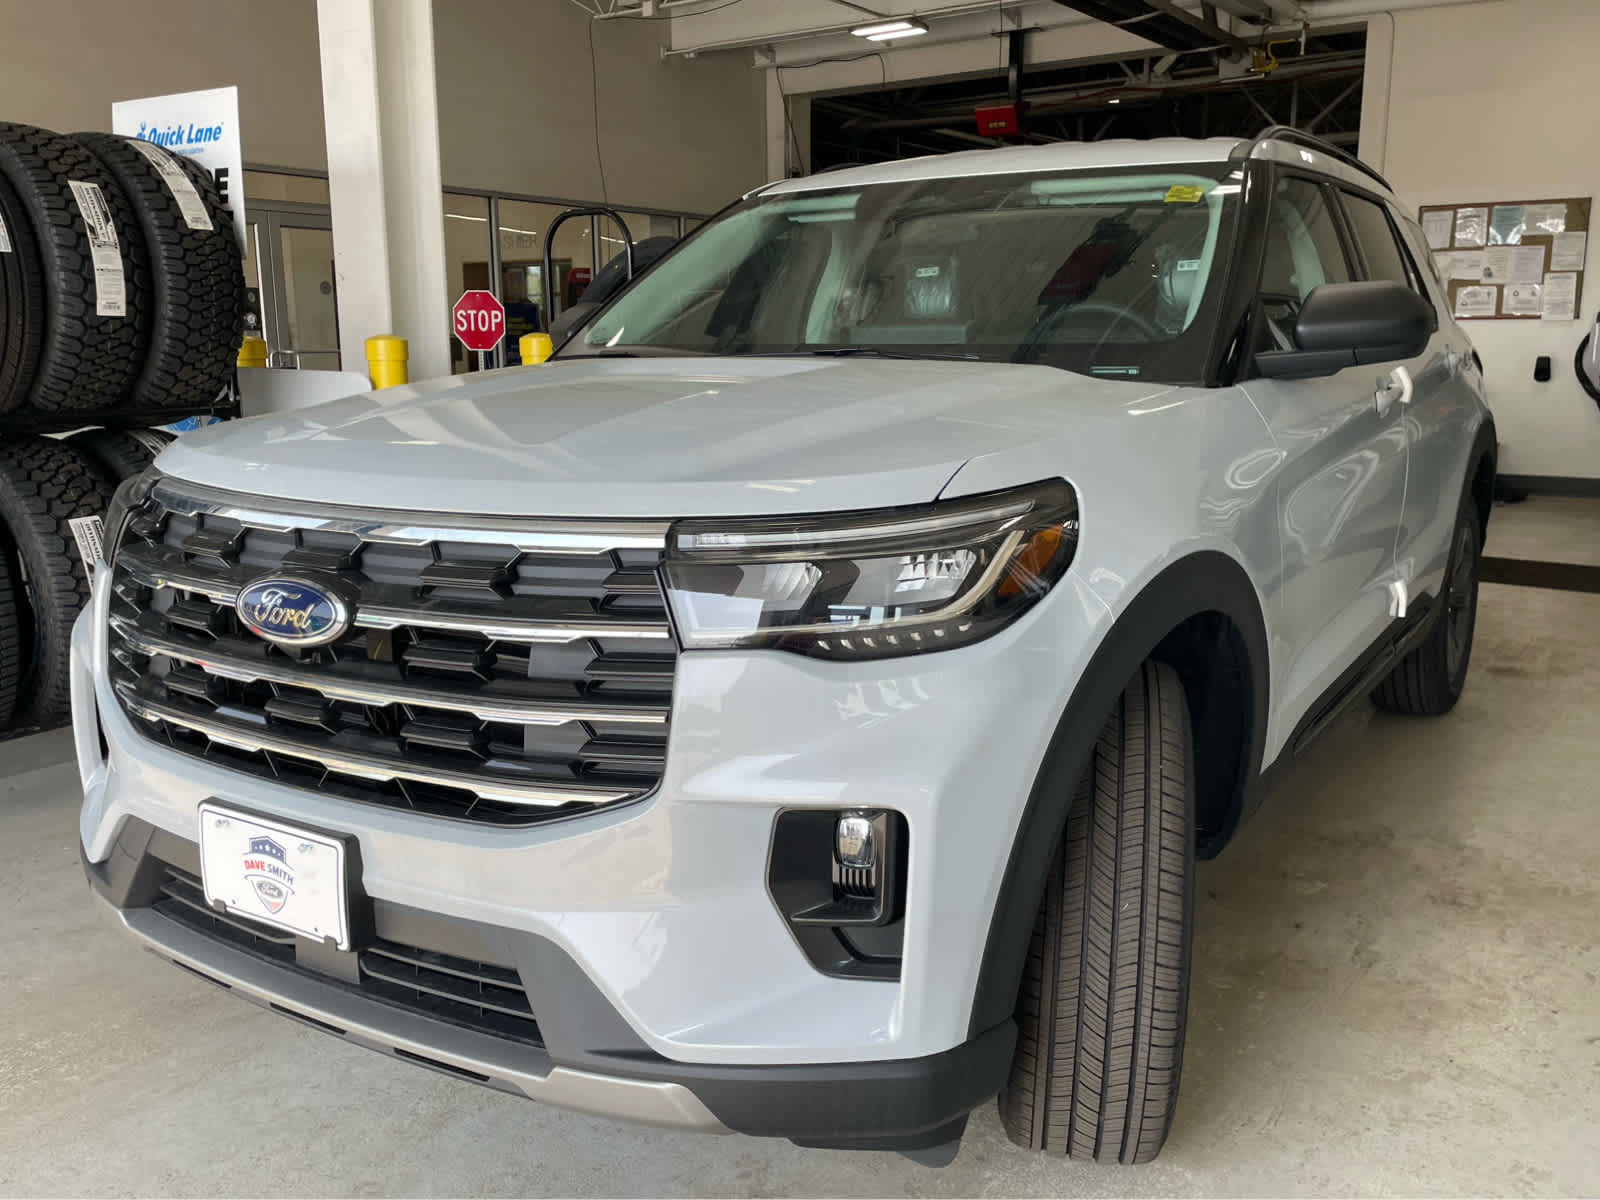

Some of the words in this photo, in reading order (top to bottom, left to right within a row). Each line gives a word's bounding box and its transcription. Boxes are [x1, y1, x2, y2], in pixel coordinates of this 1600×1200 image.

[148, 125, 184, 147] Quick
[187, 123, 222, 144] Lane
[456, 310, 502, 332] STOP
[254, 588, 315, 629] Ford
[243, 860, 265, 871] DAVE
[267, 863, 294, 886] SMITH
